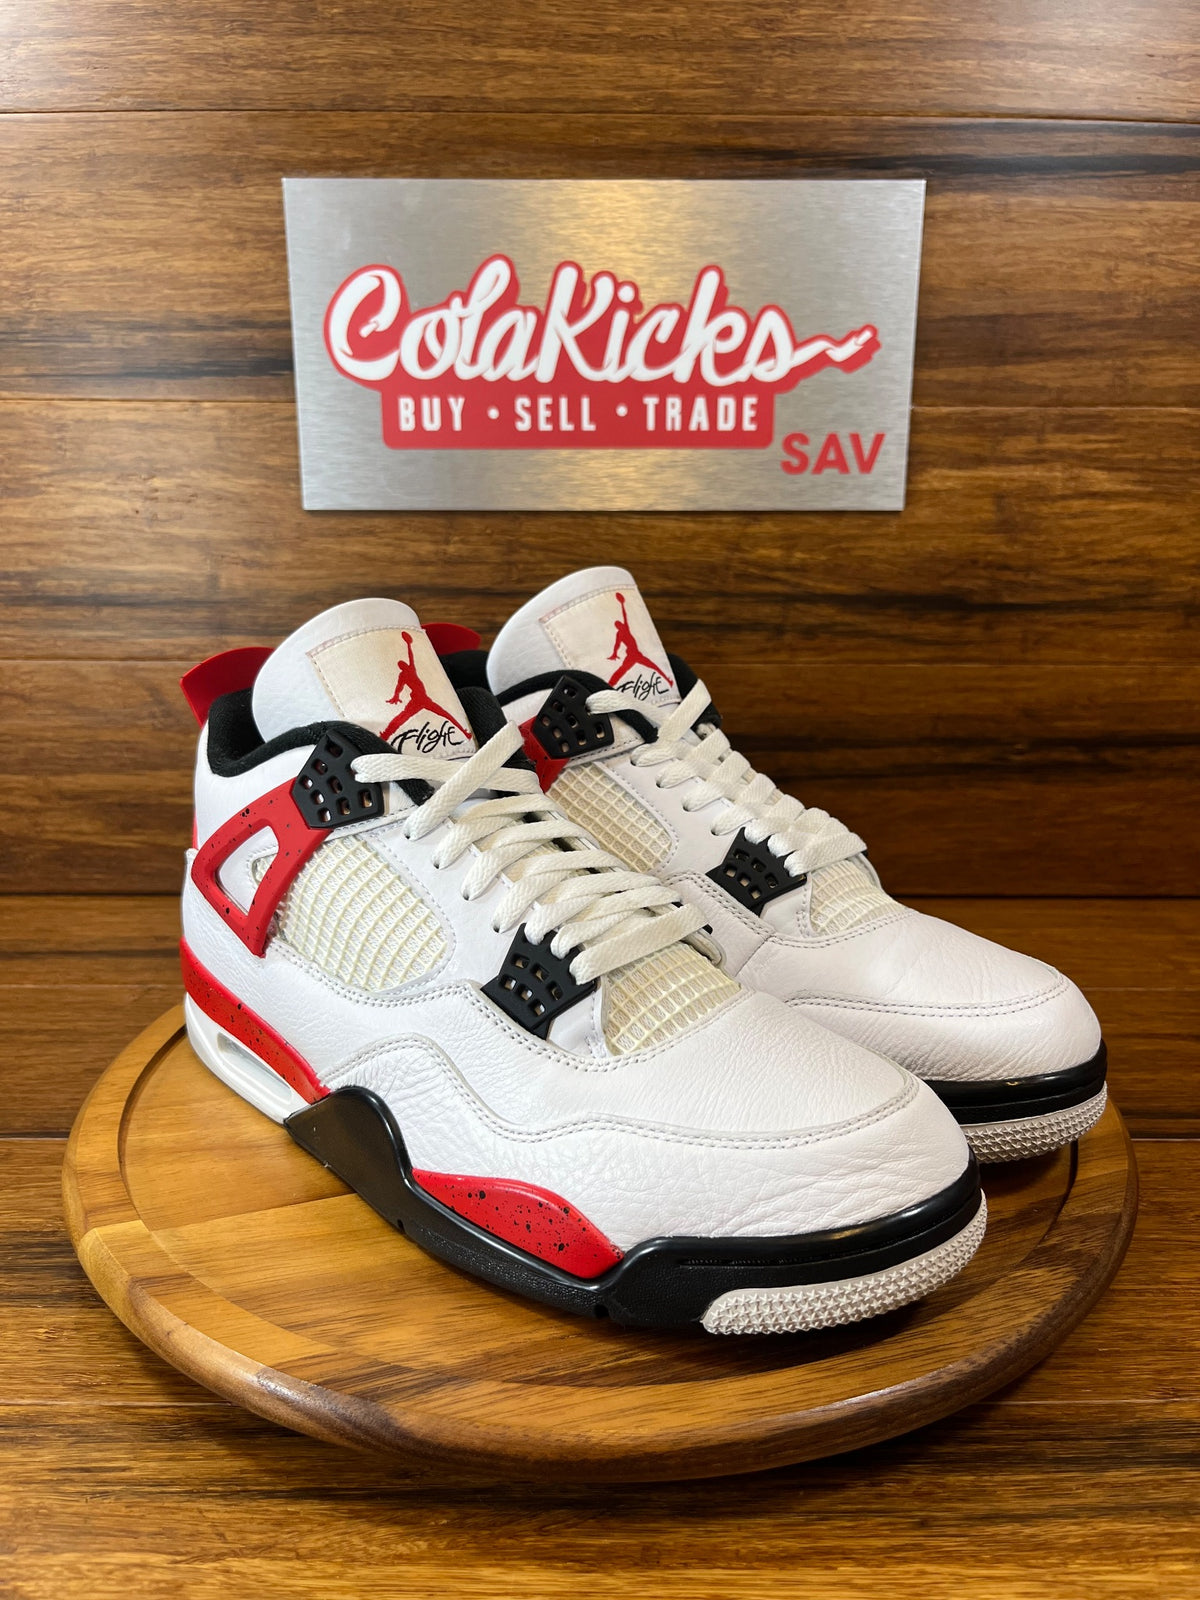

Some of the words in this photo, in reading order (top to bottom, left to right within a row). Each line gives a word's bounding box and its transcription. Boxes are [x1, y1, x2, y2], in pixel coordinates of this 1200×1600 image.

[326, 256, 877, 388] ColaKicks
[397, 394, 466, 433] BUY
[514, 394, 597, 433] SELL
[643, 394, 759, 433] TRADE
[780, 432, 886, 476] SAV
[389, 719, 466, 755] Flight
